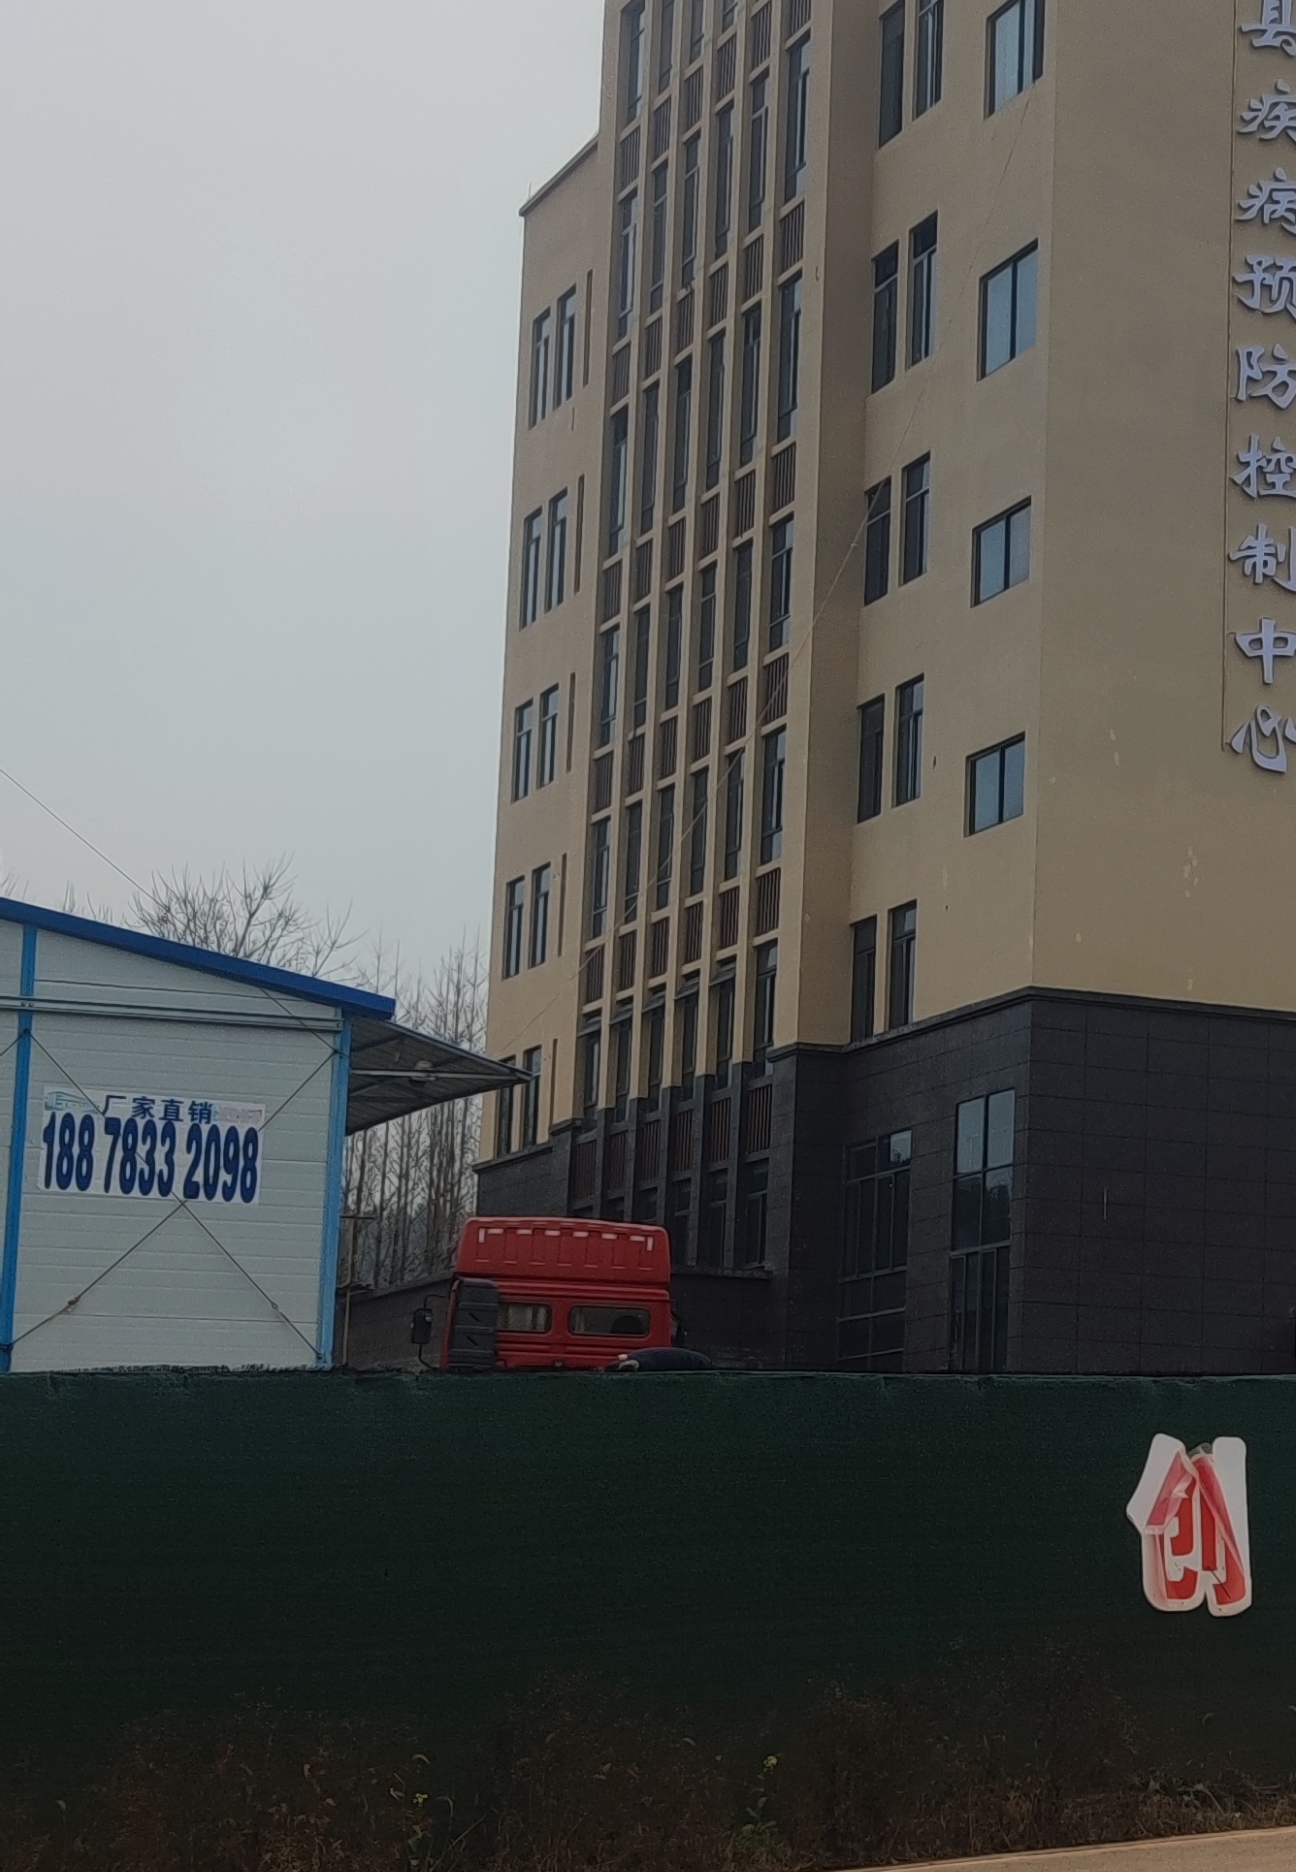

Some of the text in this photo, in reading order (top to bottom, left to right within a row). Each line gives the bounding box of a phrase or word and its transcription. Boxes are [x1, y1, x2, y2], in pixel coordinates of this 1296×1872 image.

[102, 1094, 213, 1124] 厂家直销
[43, 1112, 258, 1203] 188 7833 2098
